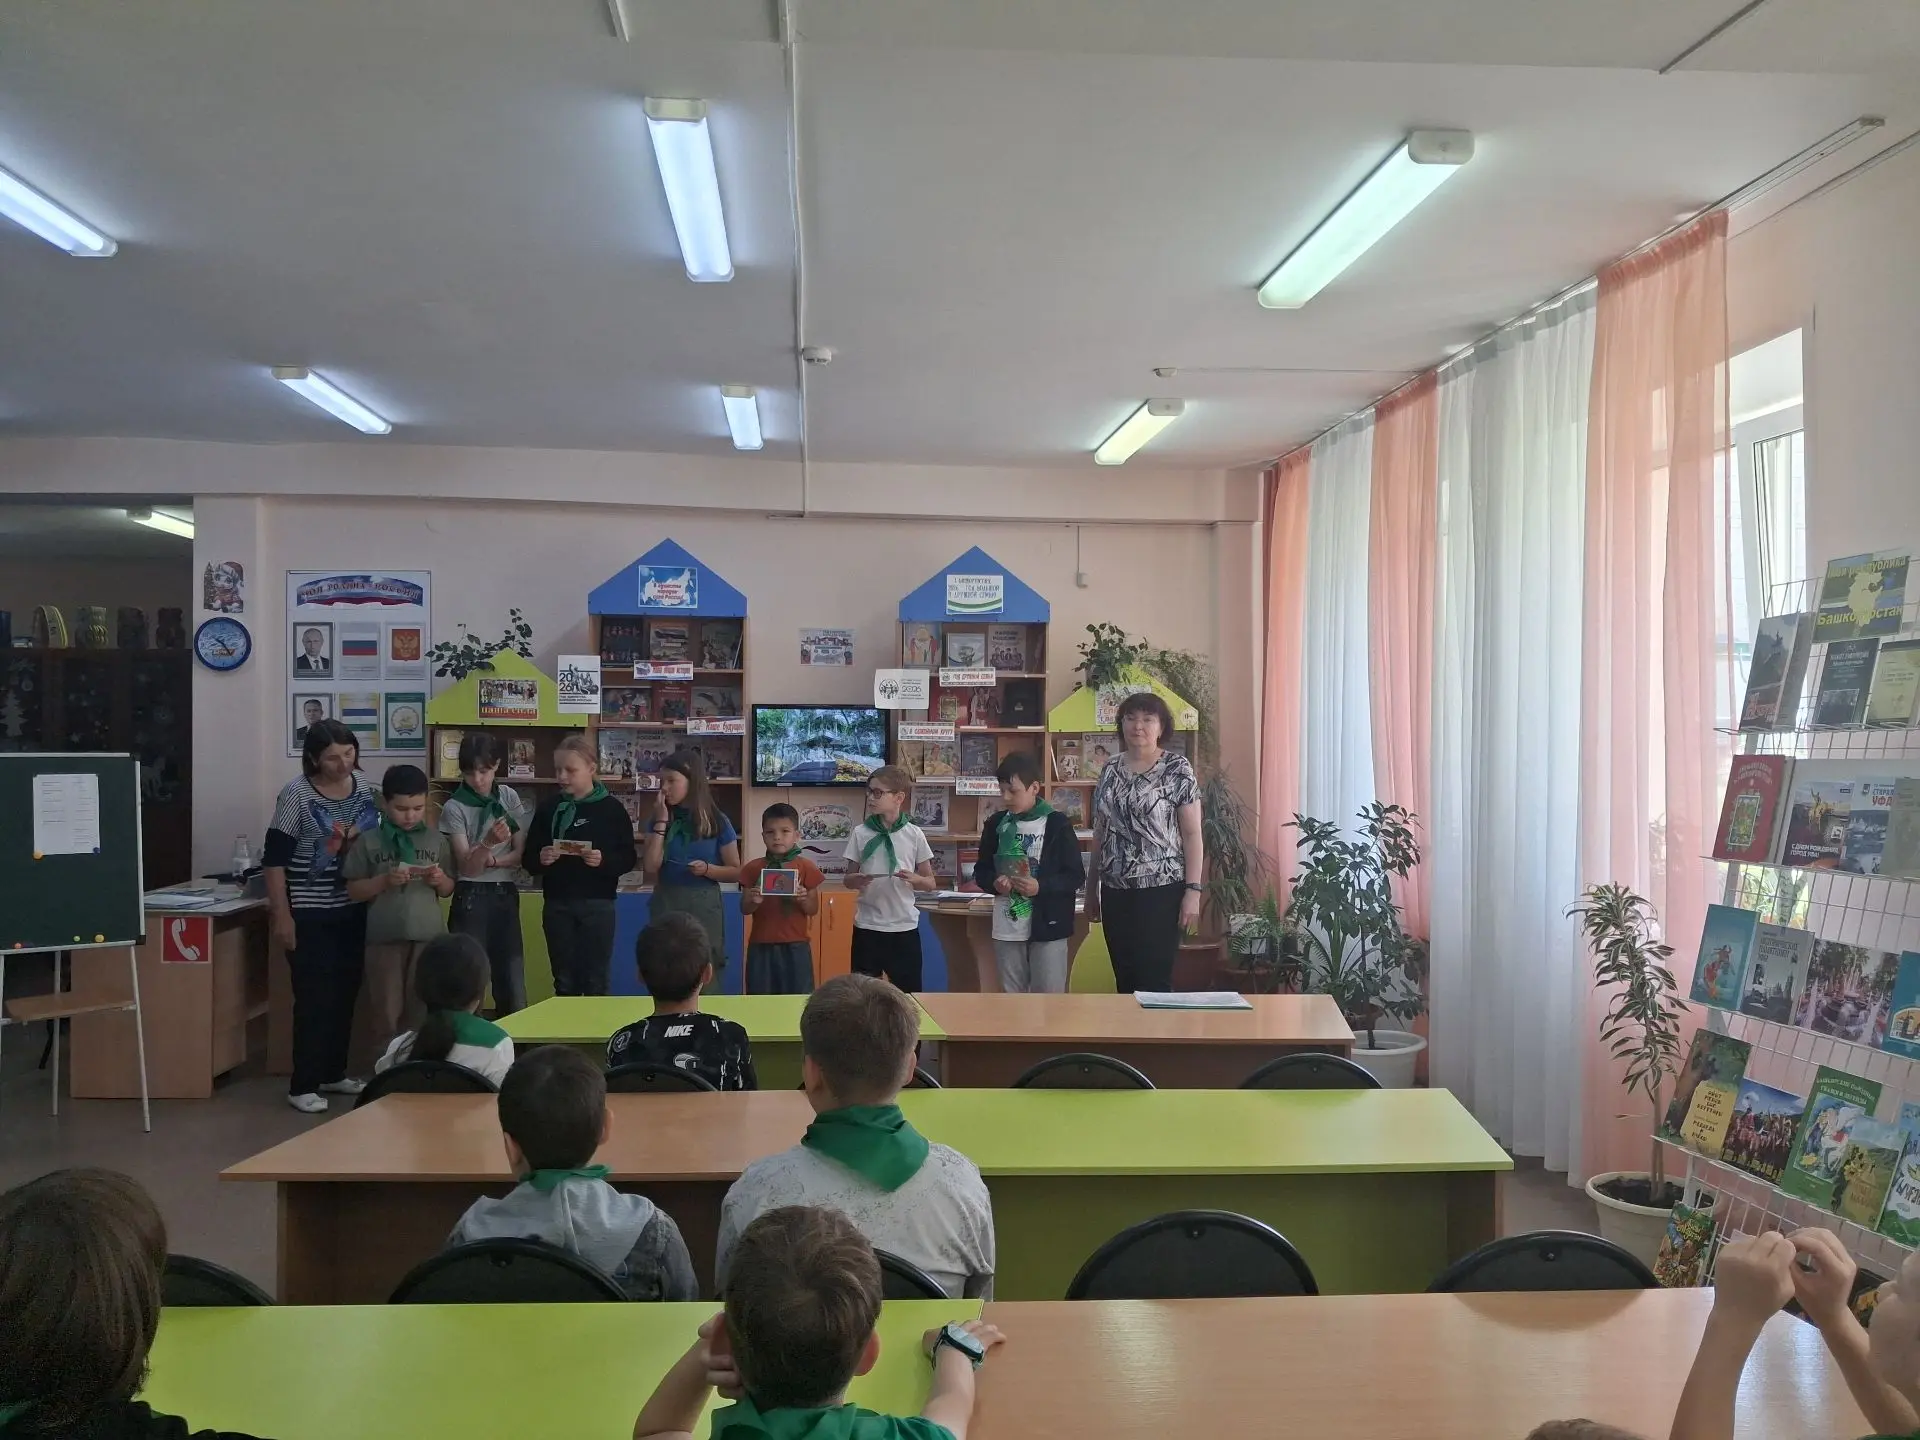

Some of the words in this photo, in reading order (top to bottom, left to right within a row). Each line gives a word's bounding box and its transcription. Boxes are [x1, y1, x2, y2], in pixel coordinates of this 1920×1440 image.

[559, 672, 573, 683] 20
[559, 682, 573, 692] 26
[664, 1024, 695, 1038] NIKE
